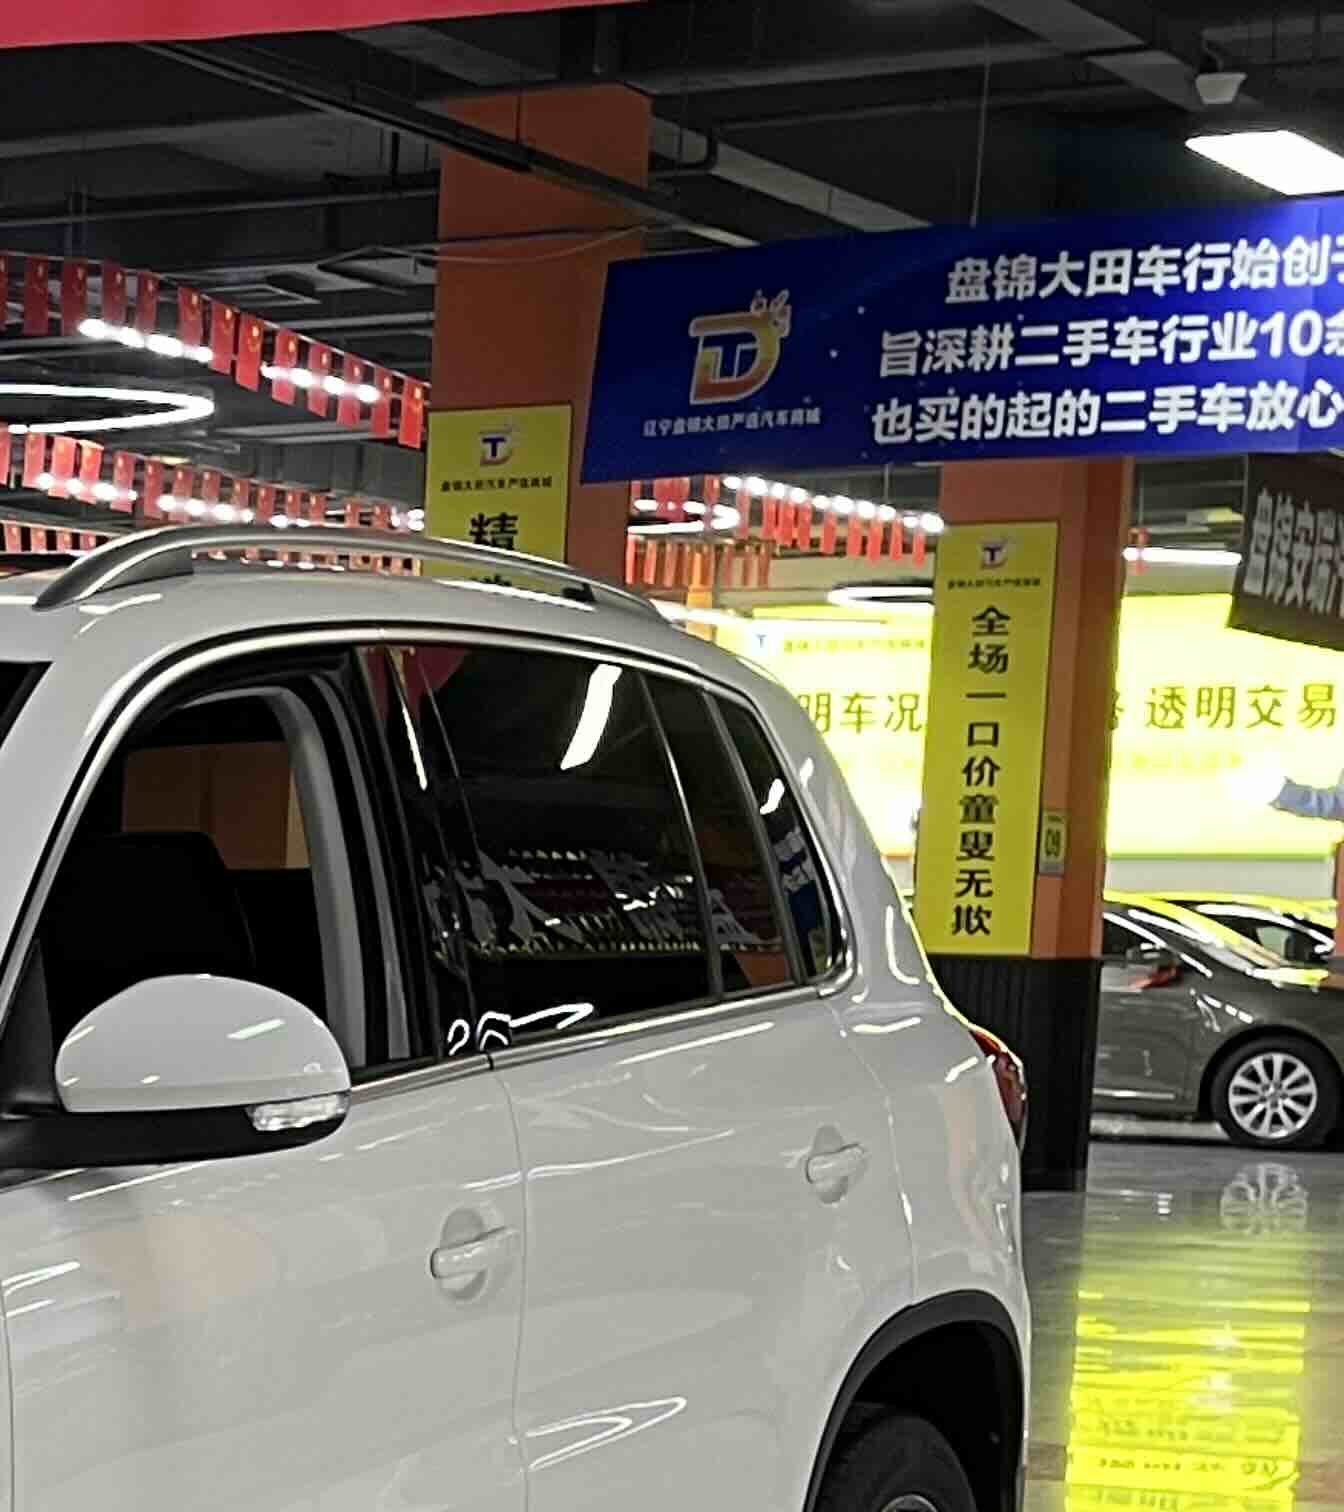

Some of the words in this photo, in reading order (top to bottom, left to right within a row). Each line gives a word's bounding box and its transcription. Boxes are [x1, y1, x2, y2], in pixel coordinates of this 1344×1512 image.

[871, 378, 1344, 445] 也买的起的二手车放心
[1146, 682, 1337, 730] 透明交易
[950, 603, 1014, 938] 全场一口价童叟无欺
